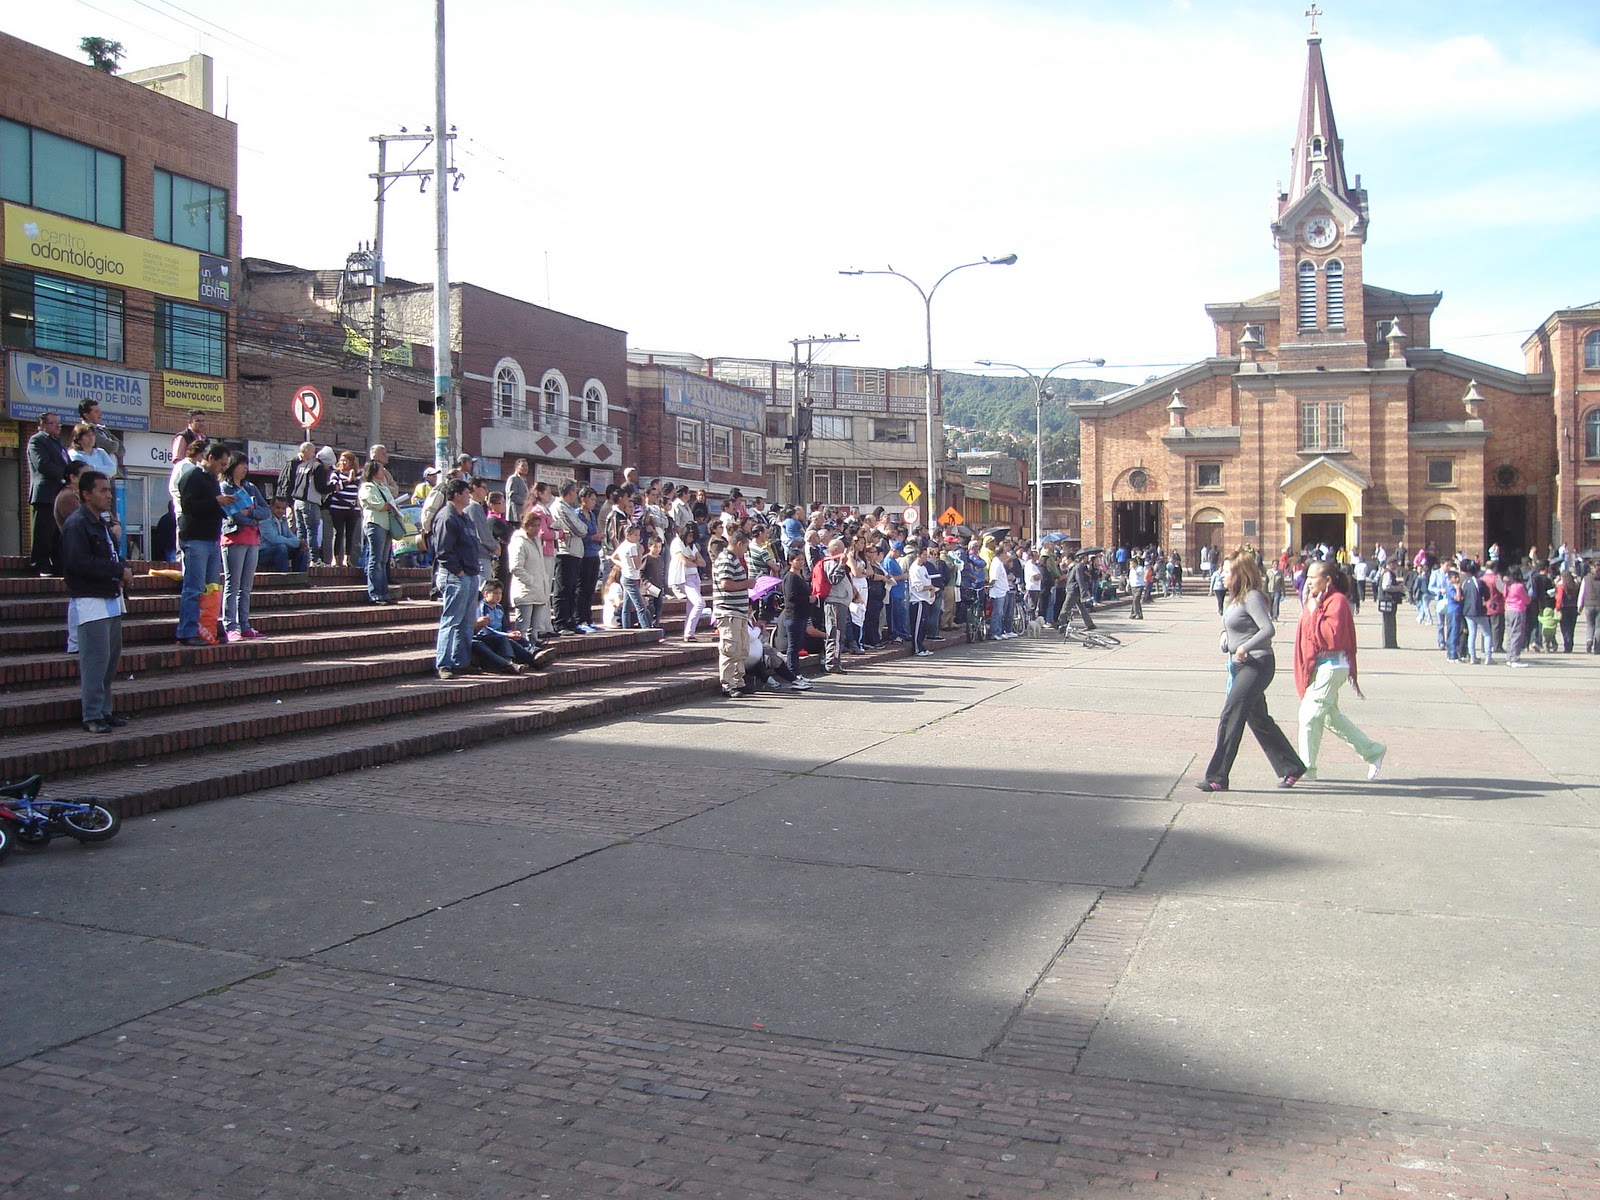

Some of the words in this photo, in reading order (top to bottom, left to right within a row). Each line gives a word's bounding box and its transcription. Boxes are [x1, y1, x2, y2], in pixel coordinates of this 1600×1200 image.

[41, 229, 86, 251] centro
[31, 242, 124, 275] odontológico
[201, 284, 230, 301] DENTAL
[168, 378, 220, 391] CONSULTORIO
[65, 387, 103, 402] MINUTO
[105, 392, 119, 404] DE
[120, 394, 143, 407] DIOS
[165, 389, 222, 403] ODONTOLOGICO
[150, 447, 174, 464] Caje
[906, 511, 915, 520] 30
